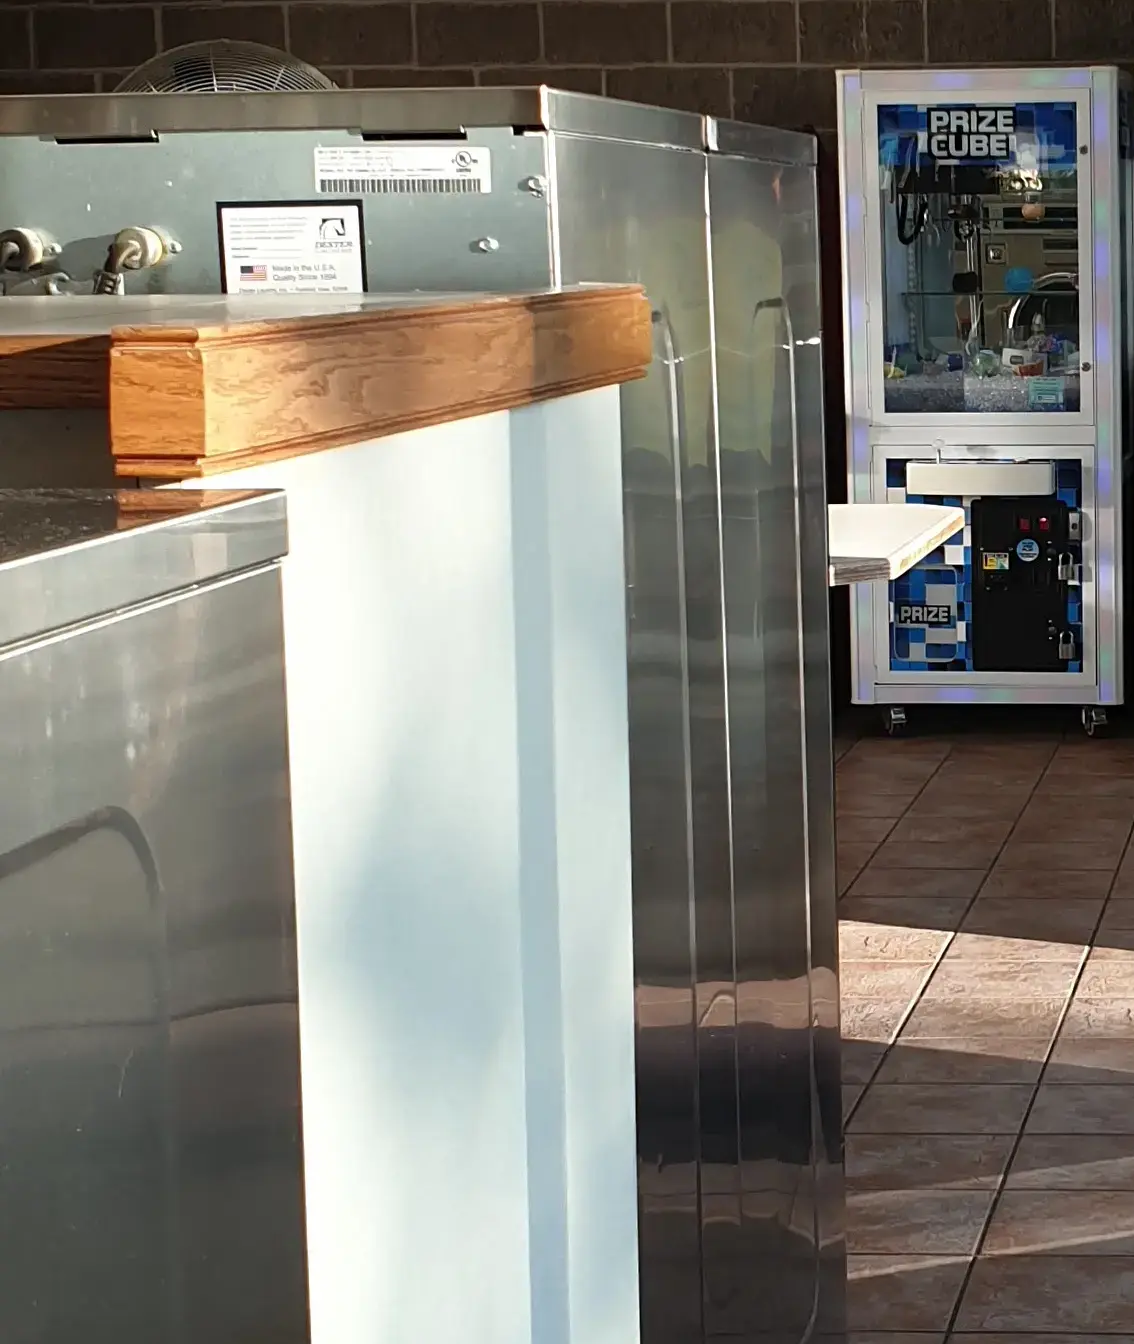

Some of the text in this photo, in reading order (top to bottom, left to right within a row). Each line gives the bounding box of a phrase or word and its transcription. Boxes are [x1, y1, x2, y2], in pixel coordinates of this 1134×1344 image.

[930, 110, 1014, 133] PRIZE
[931, 134, 1007, 157] CUBE
[900, 606, 949, 622] PRIZE
